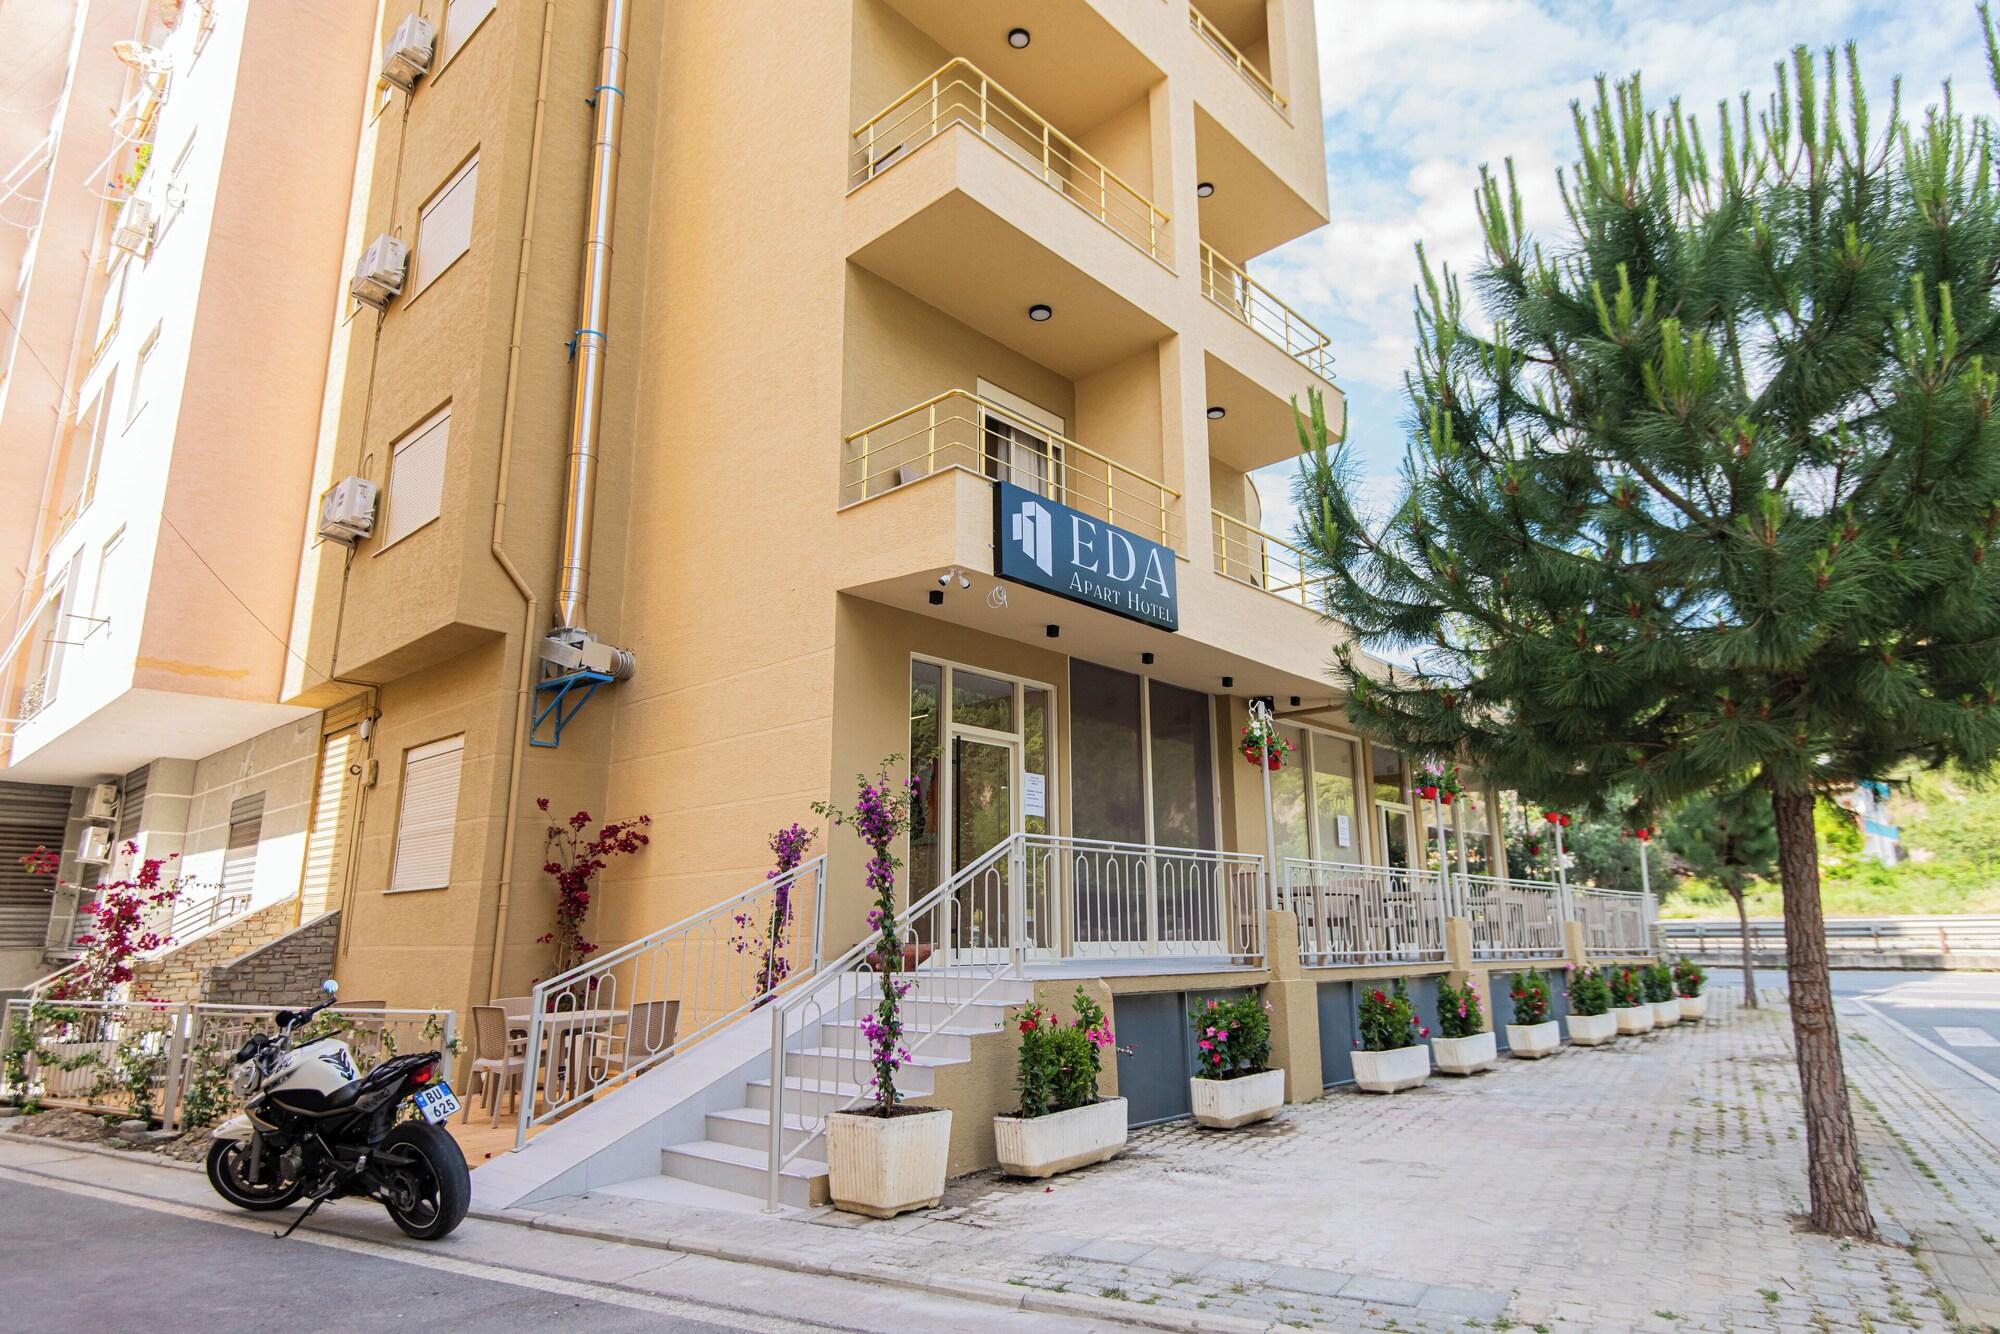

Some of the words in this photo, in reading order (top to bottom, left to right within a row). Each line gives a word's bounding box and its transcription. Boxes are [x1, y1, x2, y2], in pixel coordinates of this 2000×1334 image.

[1070, 514, 1170, 599] EDA
[1069, 571, 1121, 605] APART
[1127, 590, 1173, 622] HOTEL
[425, 1088, 442, 1104] BU
[433, 1098, 456, 1118] 625
